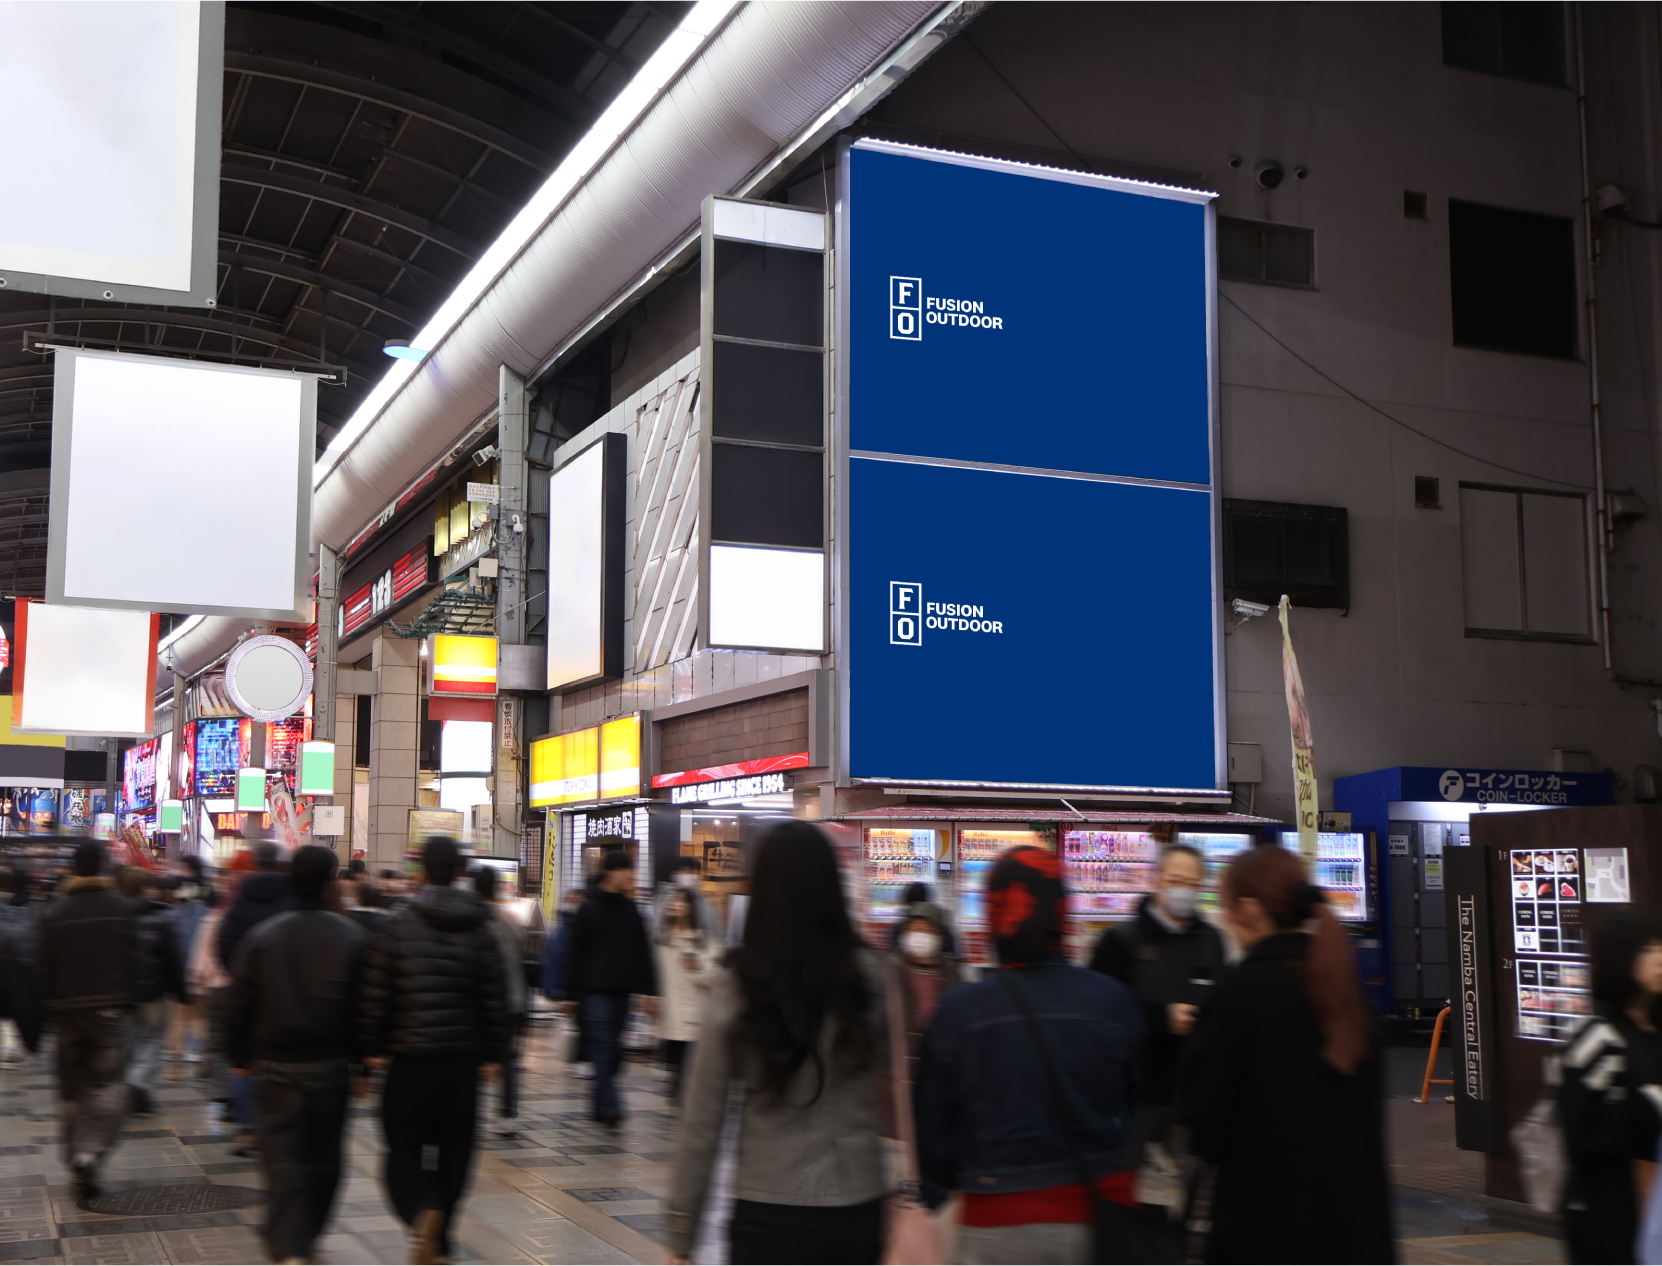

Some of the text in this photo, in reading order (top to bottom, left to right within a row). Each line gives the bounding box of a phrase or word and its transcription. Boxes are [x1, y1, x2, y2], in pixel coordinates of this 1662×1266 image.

[899, 282, 914, 304] F
[926, 297, 984, 314] FUSION
[897, 312, 915, 335] O
[925, 311, 1003, 330] OUTDOOR
[899, 587, 914, 610] F
[926, 602, 984, 618] FUSION
[897, 617, 915, 640] O
[925, 616, 1003, 634] OUTDOOR
[672, 773, 784, 804] FLAME GRILLING SINCE 1954
[1466, 772, 1577, 791] コインロッカー
[1477, 789, 1567, 804] COIN-LOCKER
[588, 815, 622, 837] 焼肉酒家
[1498, 850, 1508, 860] 1F
[1503, 958, 1513, 969] 2F
[1461, 900, 1479, 1100] The Namba Central Eatery
